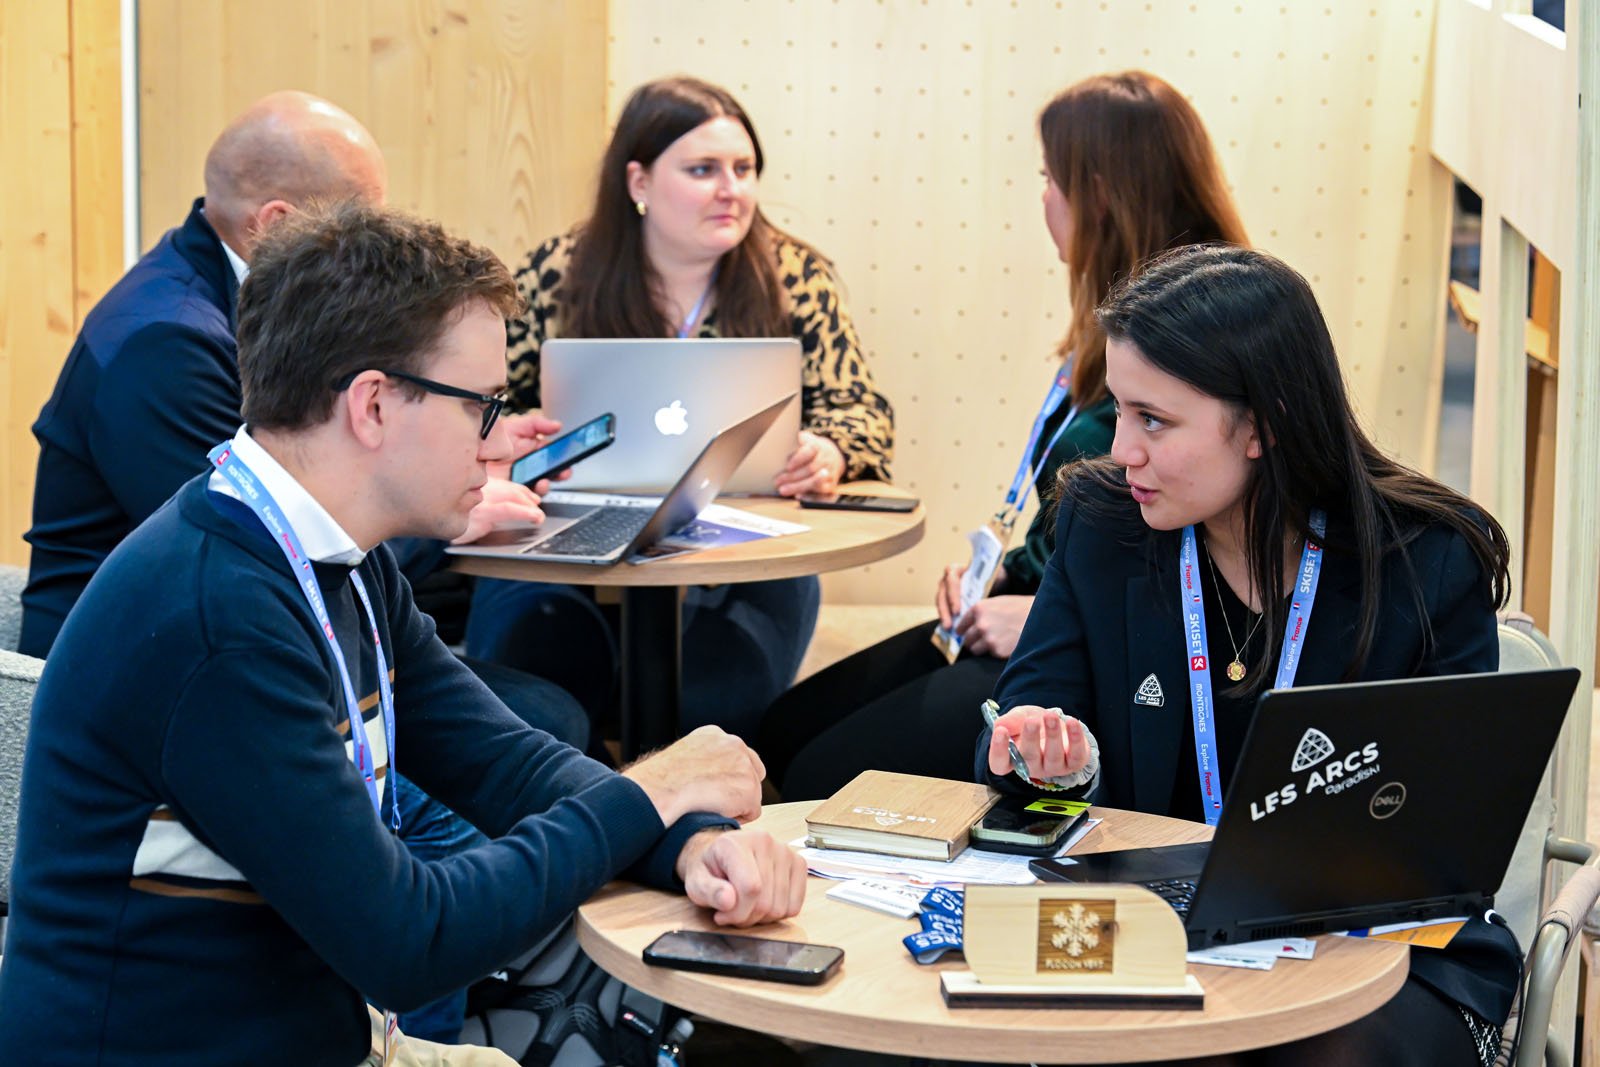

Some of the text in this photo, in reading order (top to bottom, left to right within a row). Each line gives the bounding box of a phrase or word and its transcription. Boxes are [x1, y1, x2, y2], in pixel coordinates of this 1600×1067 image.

[1300, 552, 1317, 594] SKISET
[306, 579, 327, 623] SKISET
[1189, 613, 1203, 655] SKISET
[1285, 616, 1303, 671] Explore France
[1196, 683, 1207, 733] MONTAGNES
[1201, 743, 1212, 796] Explore France
[1305, 742, 1379, 794] ARCS
[1374, 795, 1401, 807] DELL
